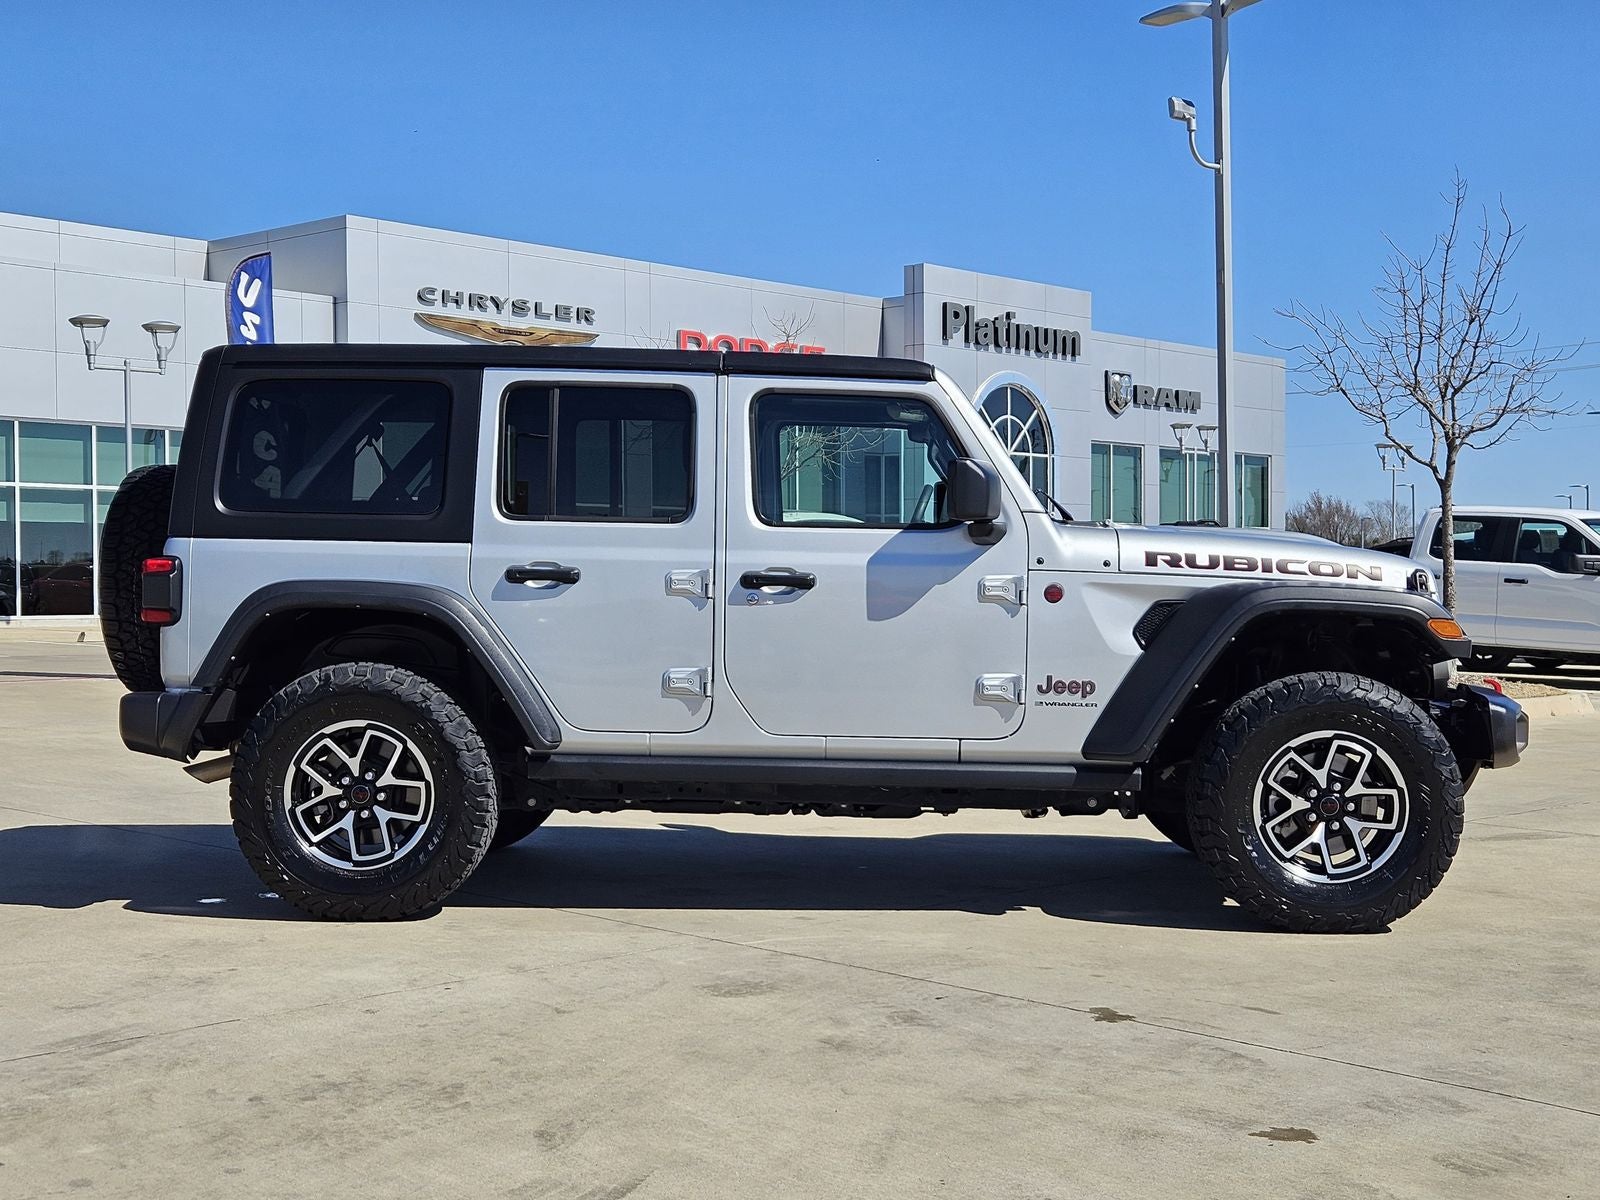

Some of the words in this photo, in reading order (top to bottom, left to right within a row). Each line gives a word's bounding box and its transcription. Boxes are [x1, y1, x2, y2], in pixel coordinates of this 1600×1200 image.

[417, 286, 596, 326] CHRYSLER
[942, 301, 1081, 360] Platinum
[1133, 385, 1202, 412] RAM
[1144, 551, 1383, 581] RUBICON
[1037, 675, 1096, 698] Jeep
